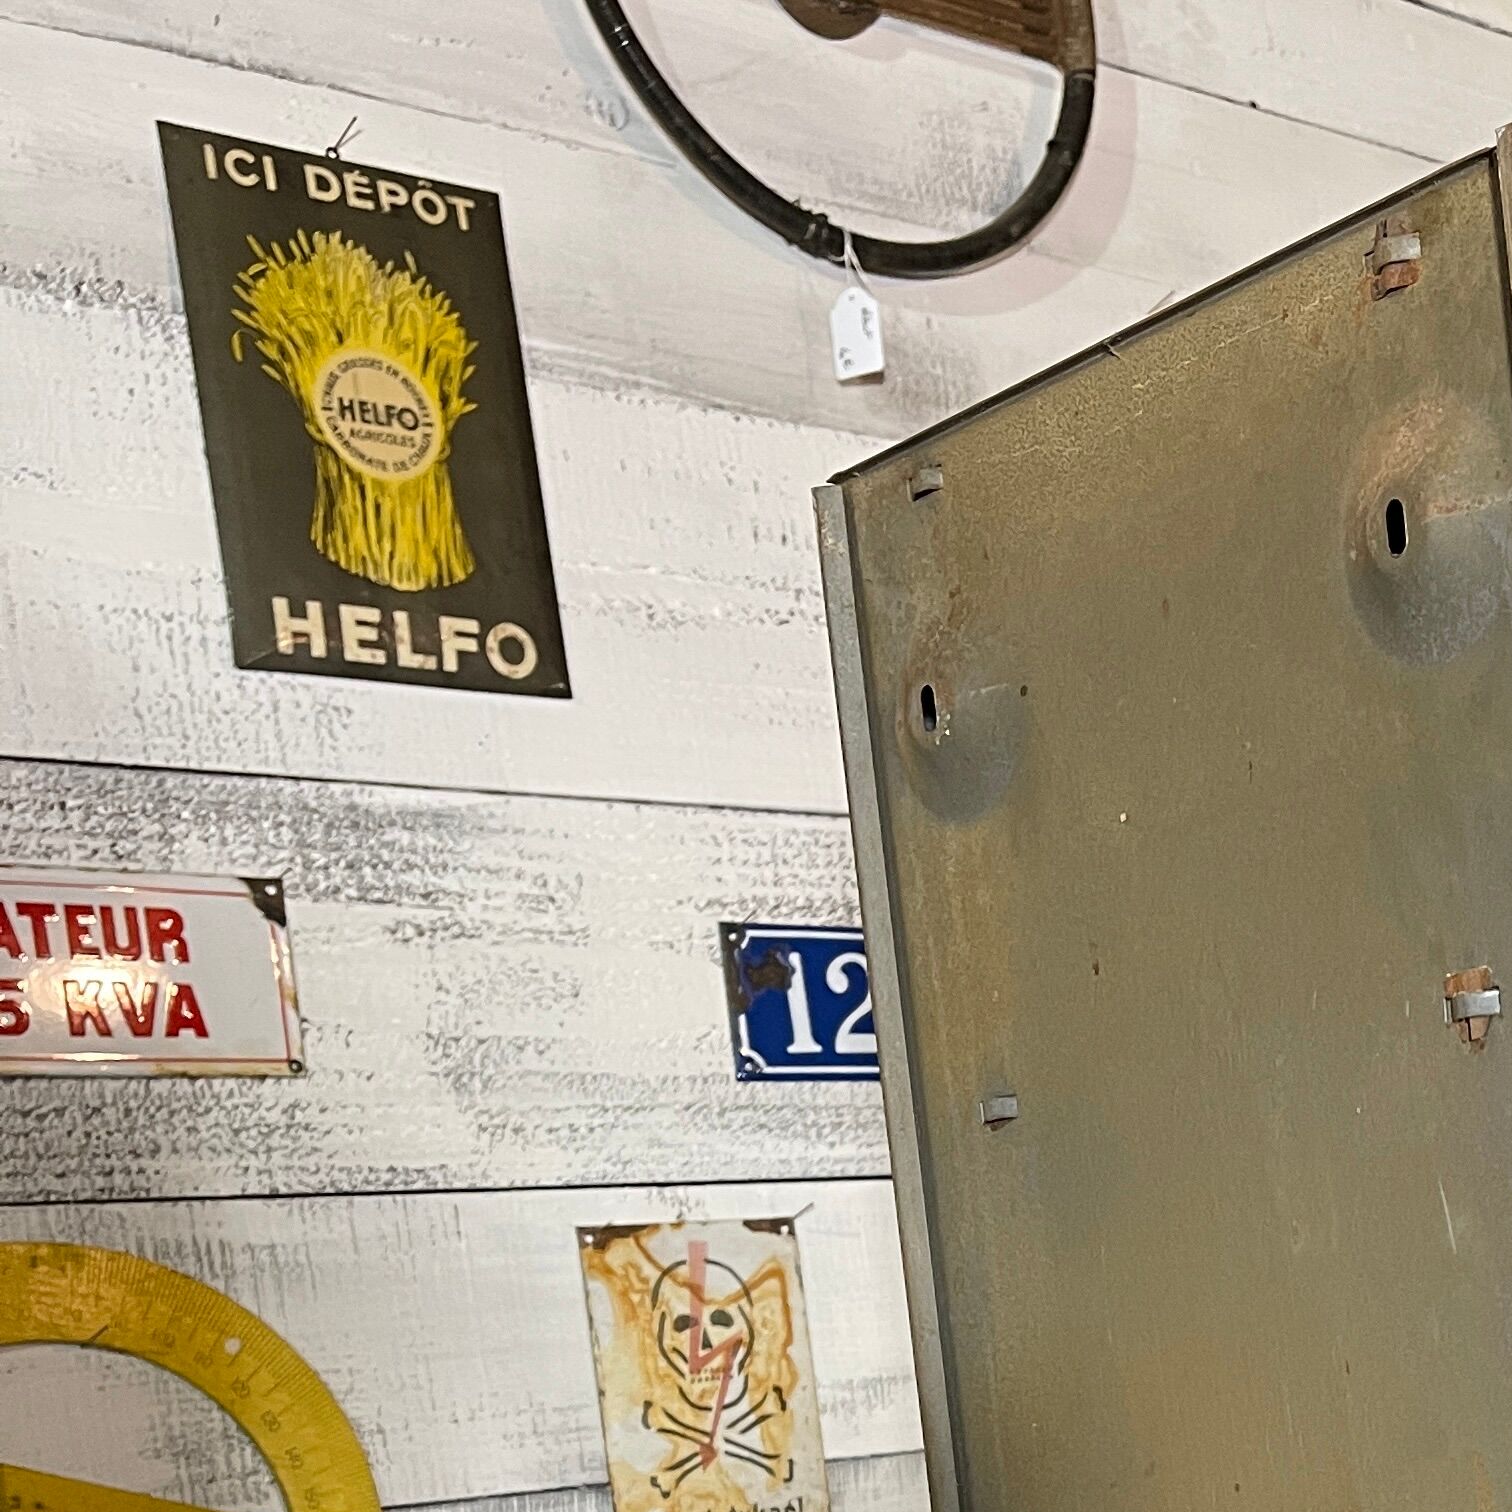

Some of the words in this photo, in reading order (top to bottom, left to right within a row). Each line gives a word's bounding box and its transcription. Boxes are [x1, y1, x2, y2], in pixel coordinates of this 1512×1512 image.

[202, 143, 277, 192] ICI
[304, 164, 476, 233] DÉPÔT
[337, 395, 419, 431] HELFO
[272, 595, 538, 680] HELFO
[63, 980, 209, 1038] KVA
[786, 952, 878, 1053] 12
